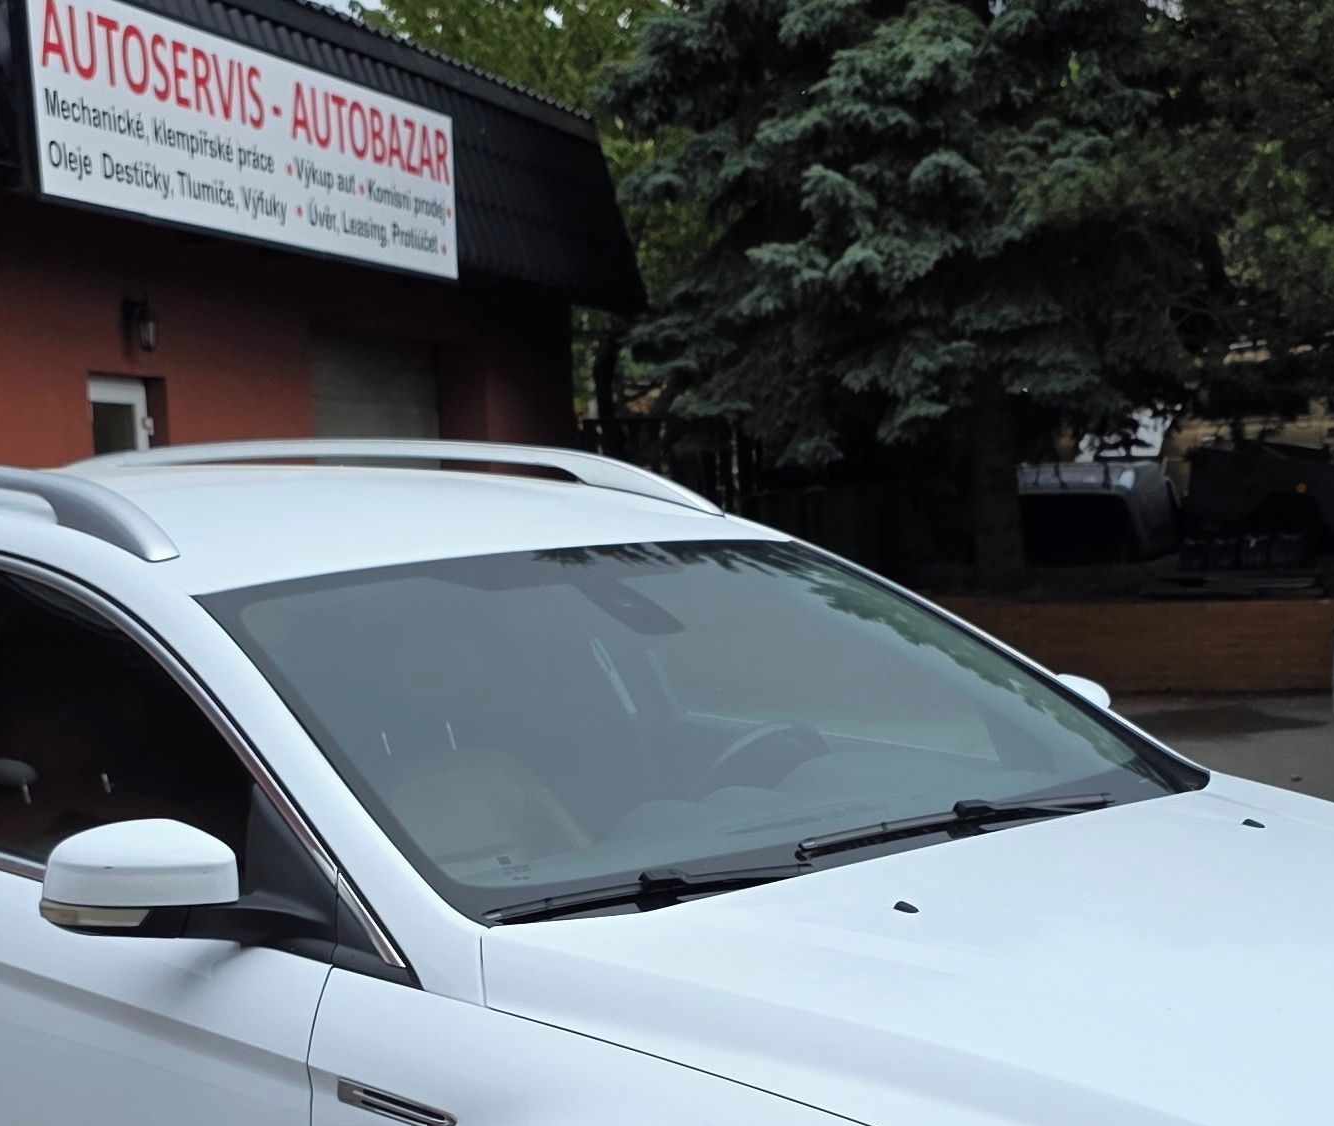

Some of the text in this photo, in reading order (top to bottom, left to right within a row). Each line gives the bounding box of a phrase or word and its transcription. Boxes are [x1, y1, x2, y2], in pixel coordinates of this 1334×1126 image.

[41, 0, 266, 131] AUTOSERVIS
[292, 81, 451, 186] AUTOBAZAR
[44, 87, 150, 146] Mechanické,
[237, 142, 275, 174] práce
[47, 139, 288, 227] Oleje Destičky, Tlumiče, Výfuky
[294, 156, 356, 196] Výkup aut
